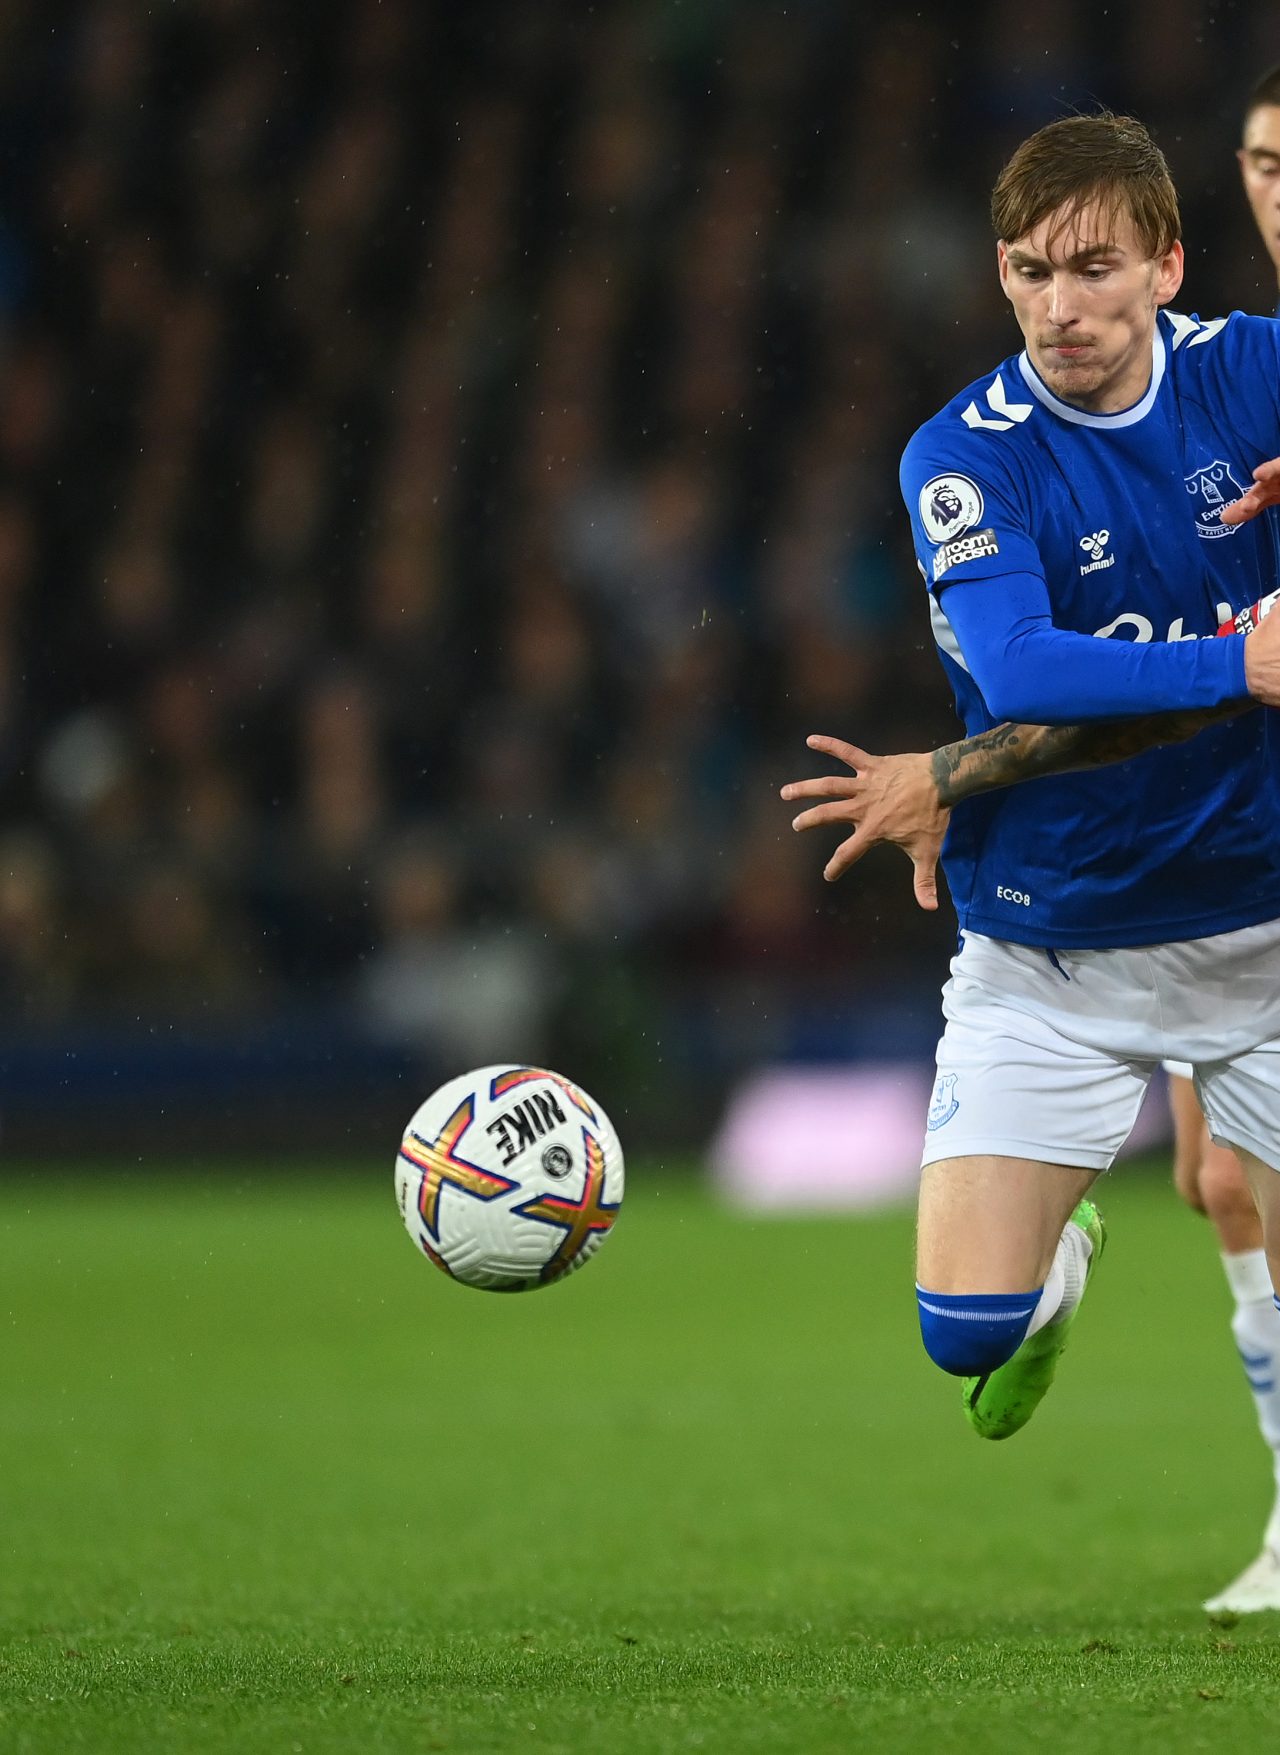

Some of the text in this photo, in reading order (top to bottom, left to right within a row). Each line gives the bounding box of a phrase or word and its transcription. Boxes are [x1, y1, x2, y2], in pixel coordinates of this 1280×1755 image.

[946, 535, 989, 555] room
[947, 544, 999, 568] racism
[997, 885, 1031, 907] ECO8
[486, 1089, 567, 1168] NIKE
